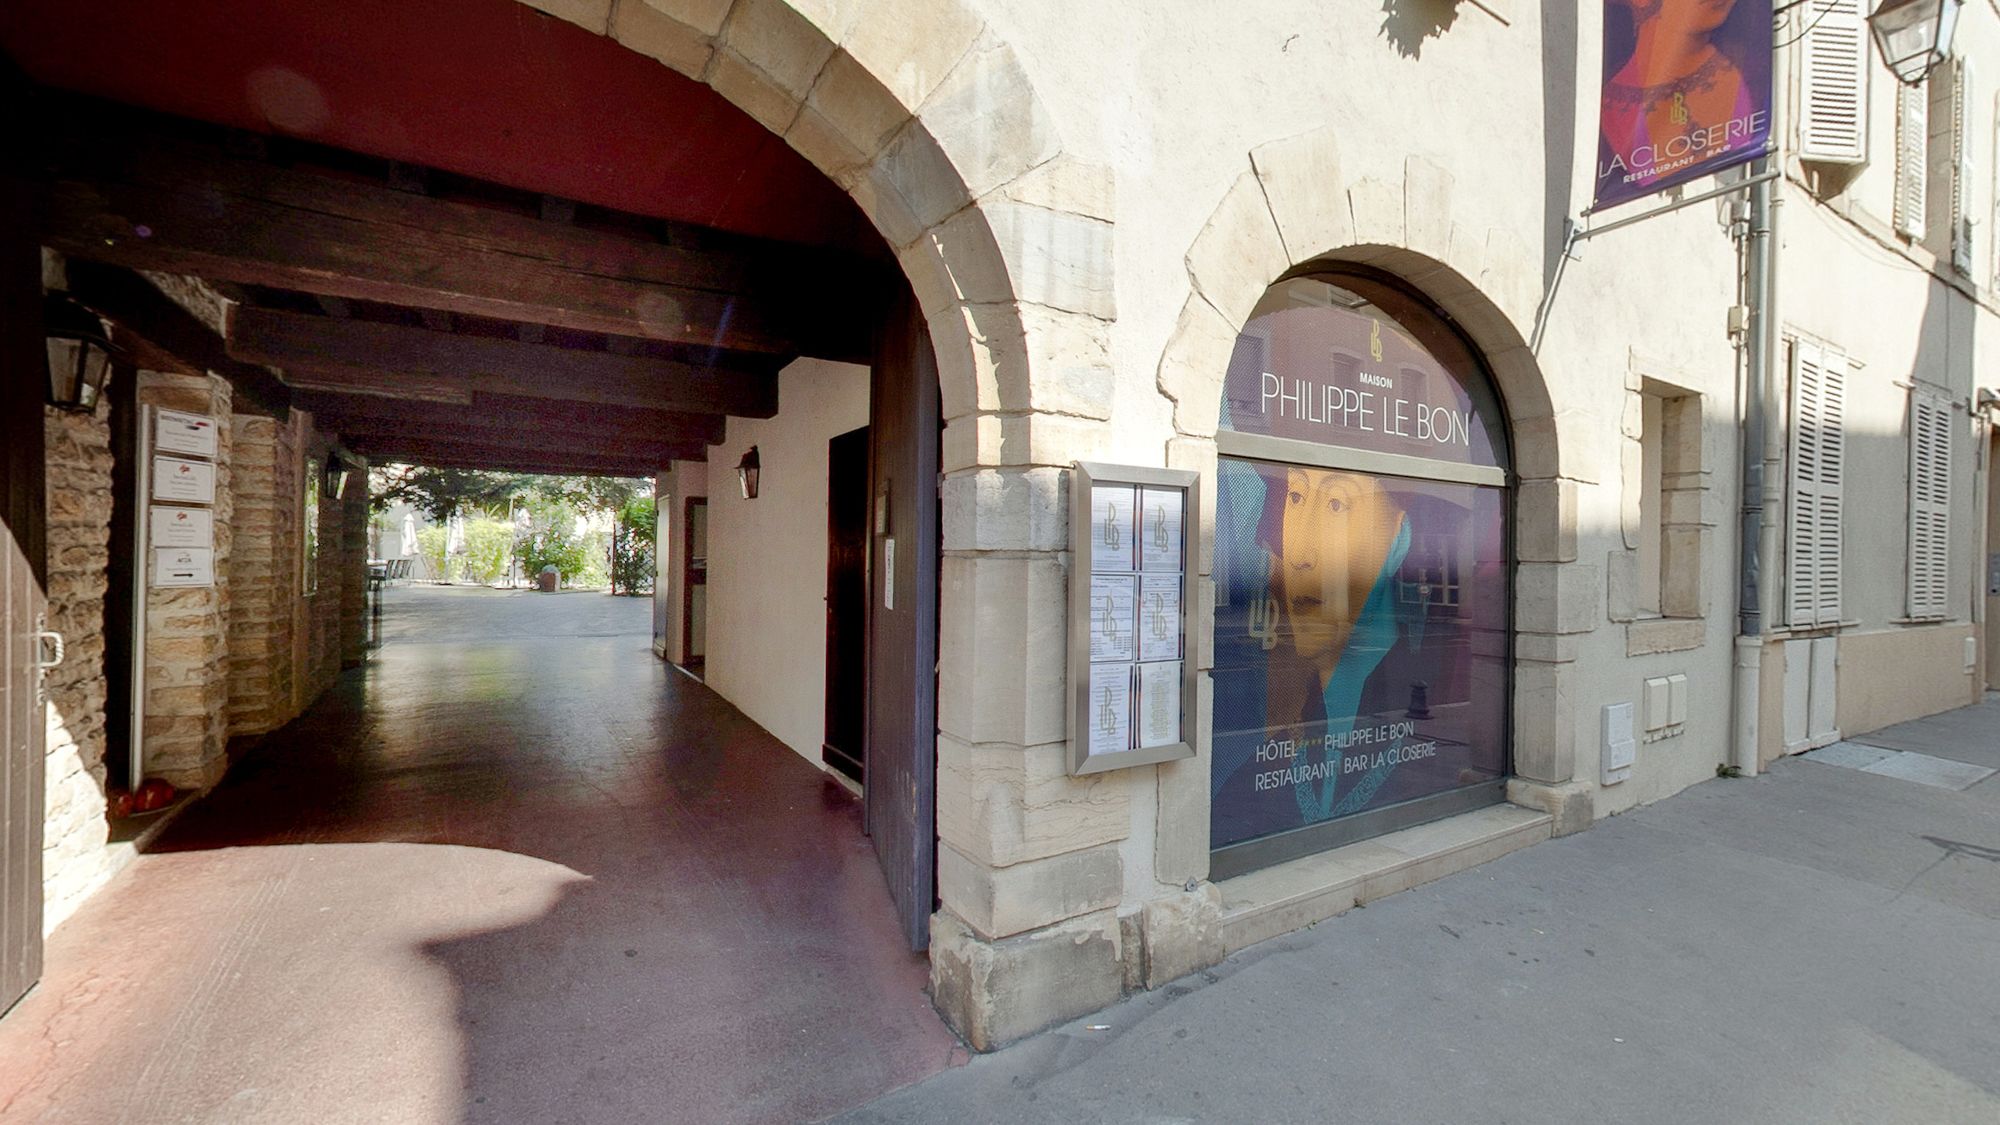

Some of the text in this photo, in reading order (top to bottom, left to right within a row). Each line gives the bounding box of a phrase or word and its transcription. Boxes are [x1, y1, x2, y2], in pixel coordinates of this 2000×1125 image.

[1598, 110, 1767, 179] LA CLOSERIE
[1623, 144, 1732, 183] RESTAURANT BAR
[1359, 372, 1393, 389] MAISON
[1262, 372, 1469, 446] PHILIPPE LE BON
[1255, 721, 1415, 763] HÔTEL PHILIPPE LE BON
[1255, 741, 1437, 791] RESTAURANT BAR LA CLOSERIE
